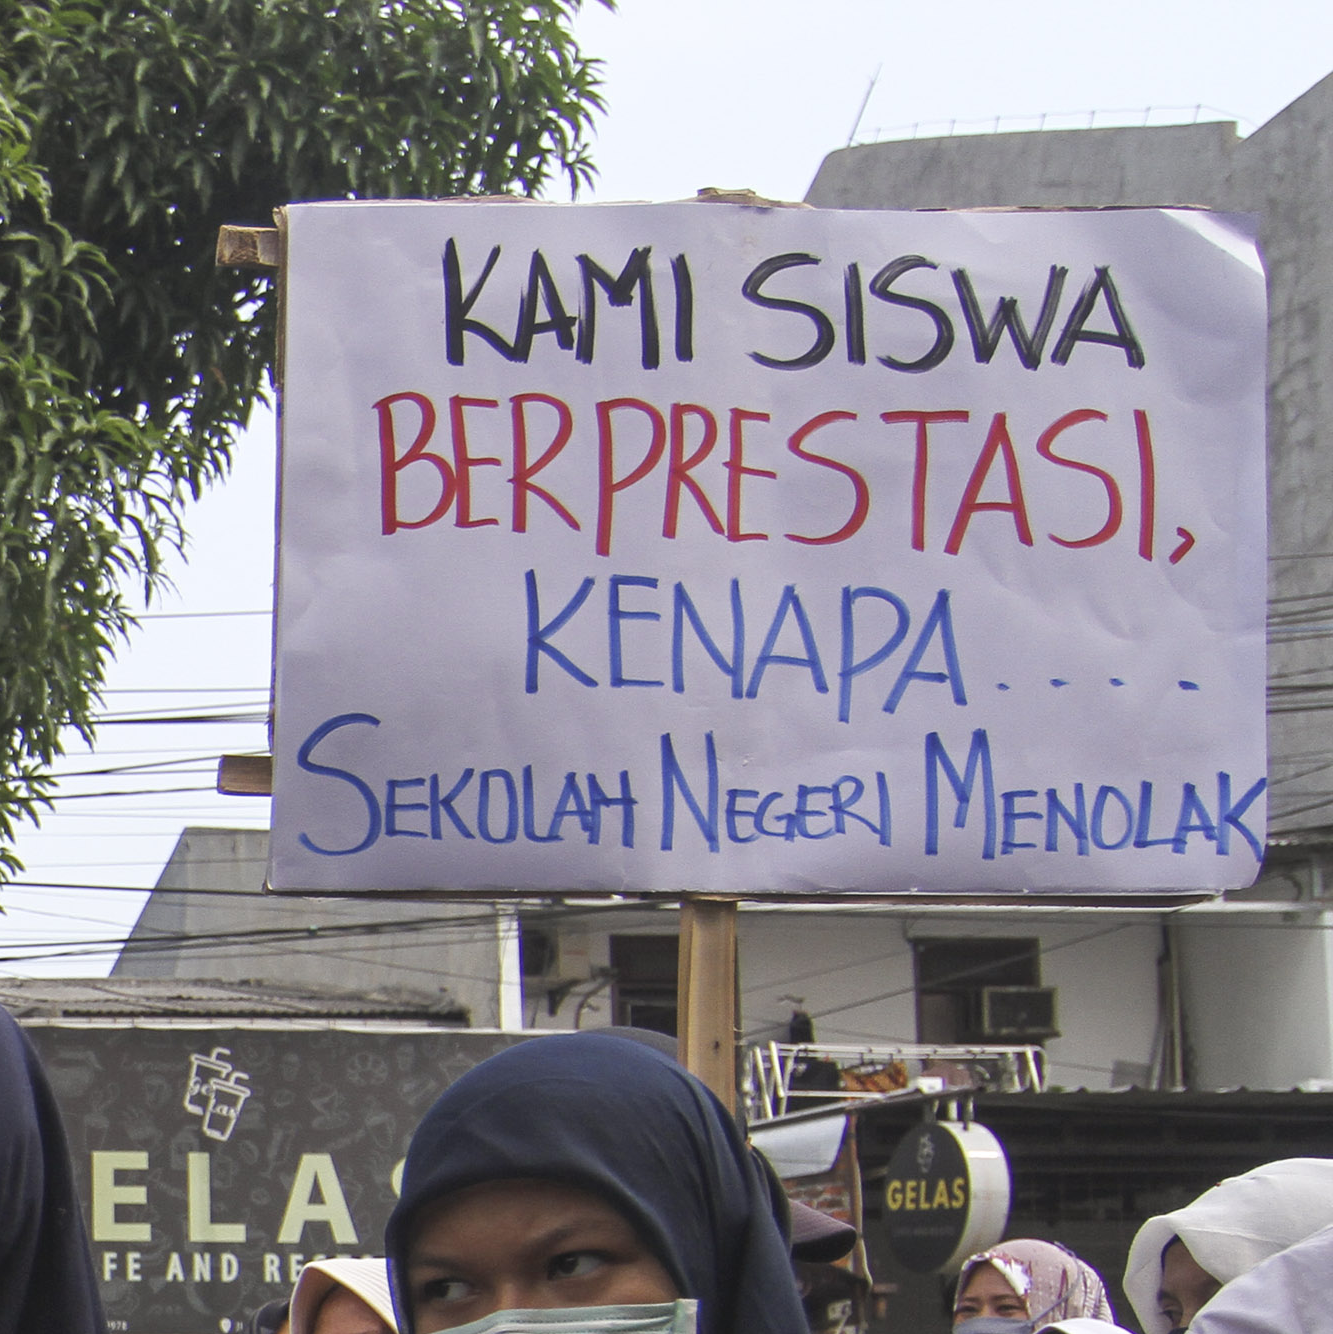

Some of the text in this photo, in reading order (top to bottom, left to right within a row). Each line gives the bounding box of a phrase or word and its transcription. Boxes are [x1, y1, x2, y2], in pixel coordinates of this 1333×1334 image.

[442, 236, 1145, 375] KAMI SISWA
[372, 392, 1196, 565] BERPRESTASI,
[91, 1150, 406, 1245] ELA
[886, 1175, 967, 1211] GELAS
[103, 1252, 143, 1282] FE
[166, 1252, 241, 1284] AND
